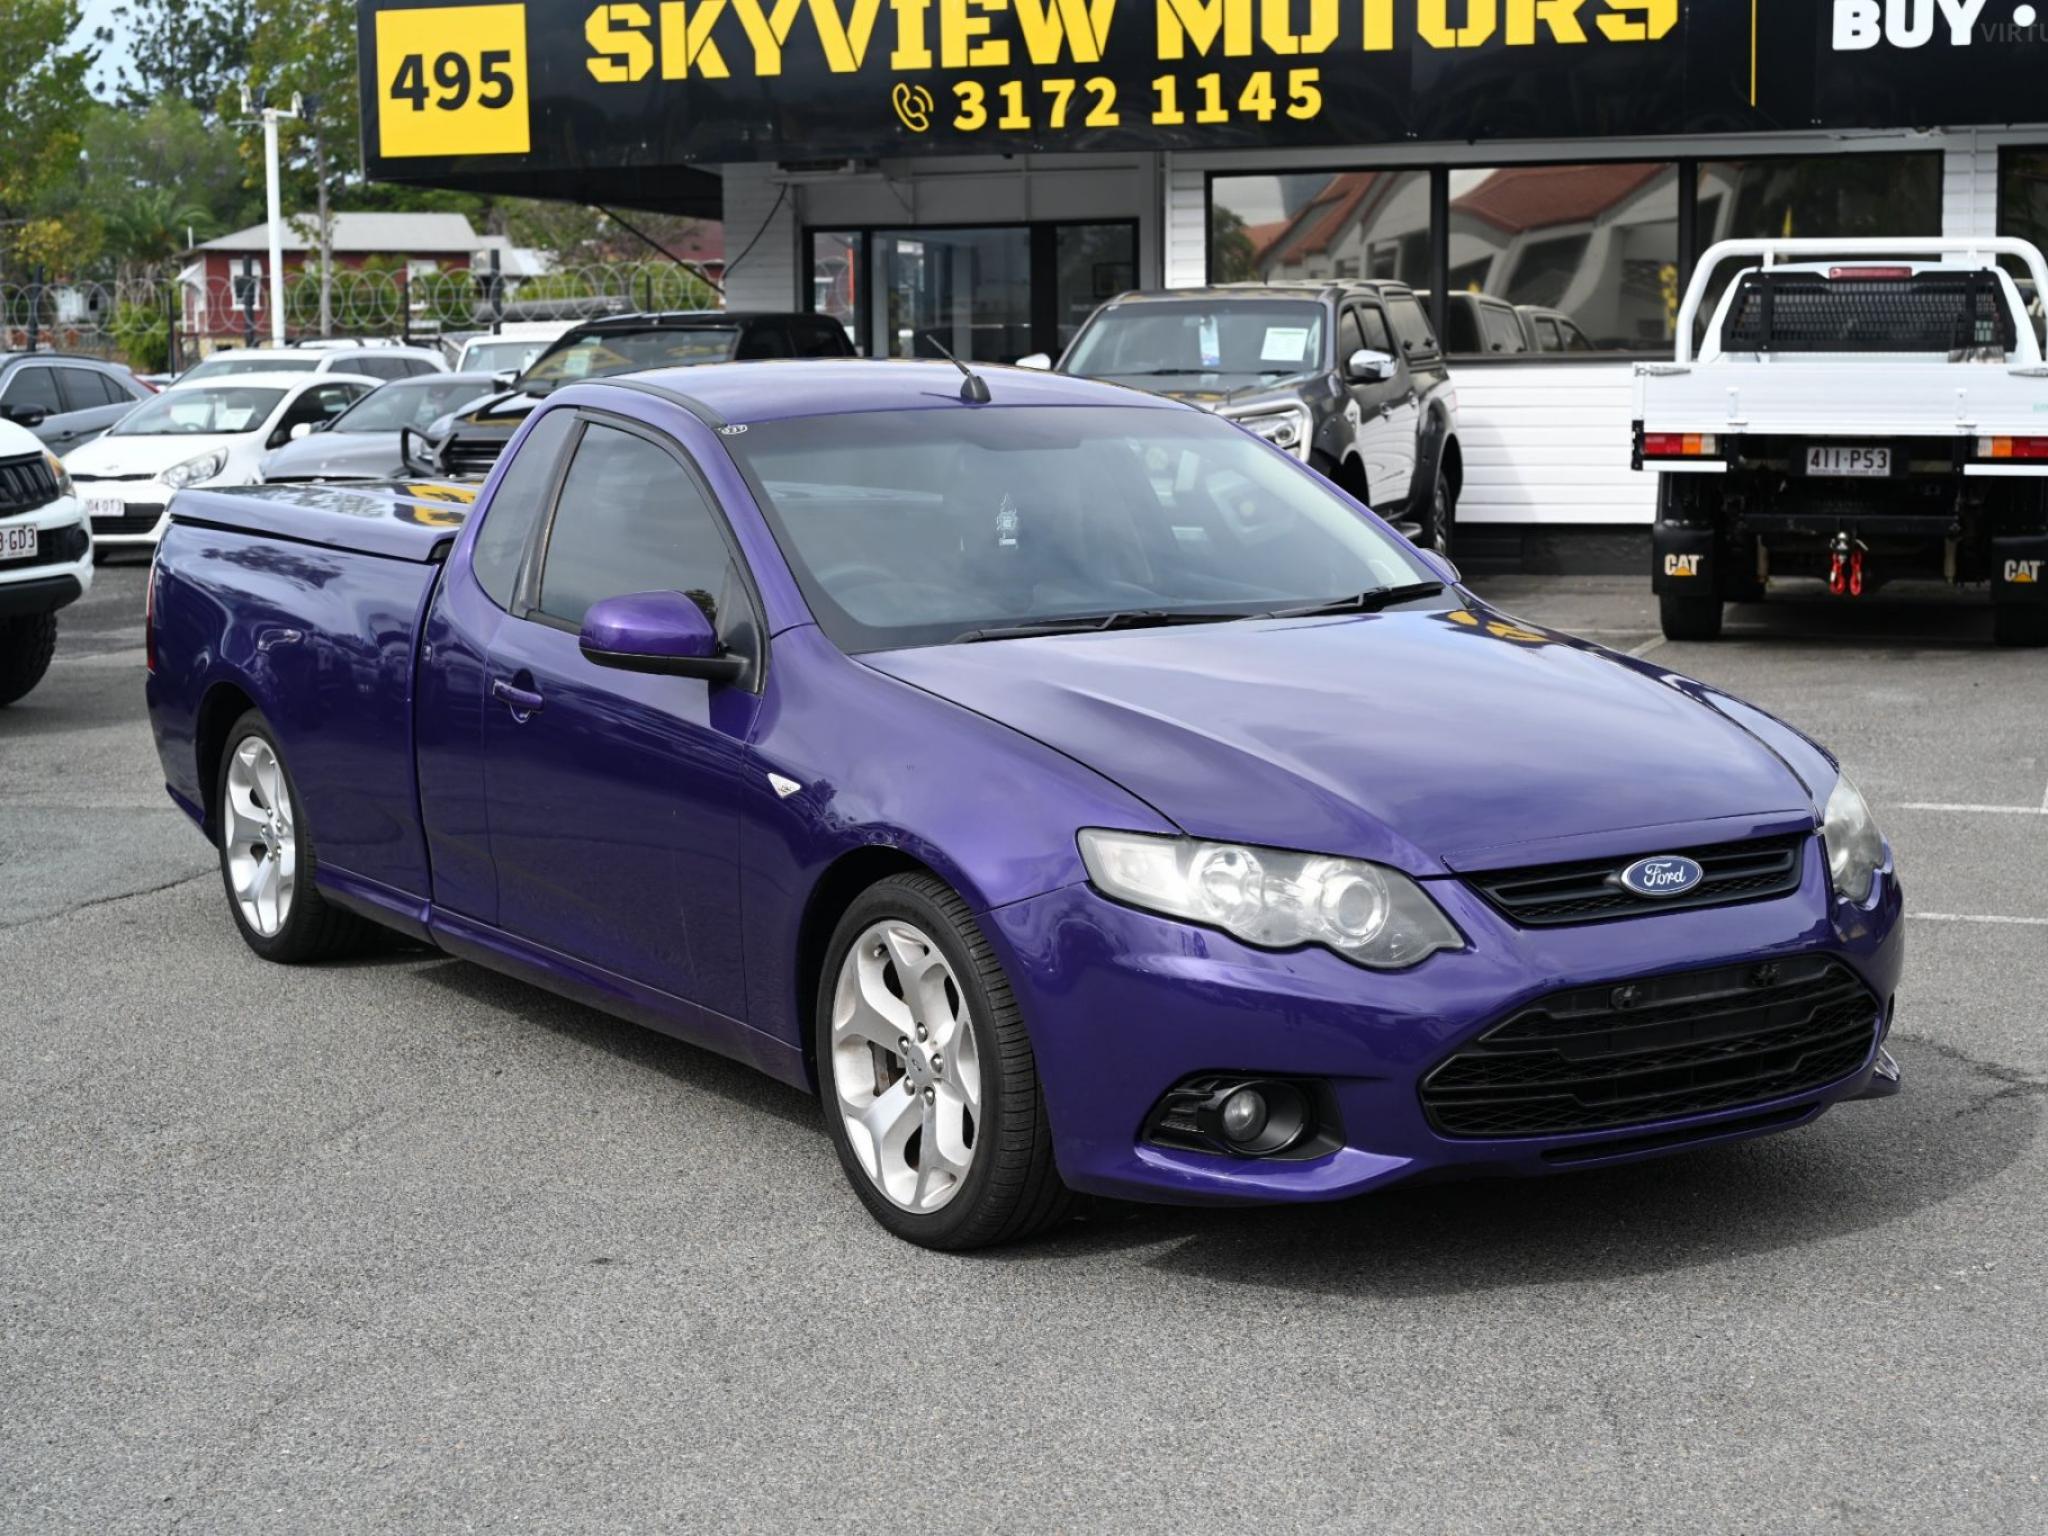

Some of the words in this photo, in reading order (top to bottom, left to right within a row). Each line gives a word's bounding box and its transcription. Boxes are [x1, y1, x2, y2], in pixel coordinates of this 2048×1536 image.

[585, 0, 1116, 82] SKYVIEW
[1157, 0, 1678, 59] MOTORS
[1832, 0, 1986, 50] BUY
[390, 50, 514, 112] 495
[952, 77, 1119, 131] 3172
[1151, 69, 1322, 125] 1145
[1664, 553, 1699, 576] CAT
[2004, 559, 2041, 582] CAT
[1643, 862, 1687, 887] Ford
